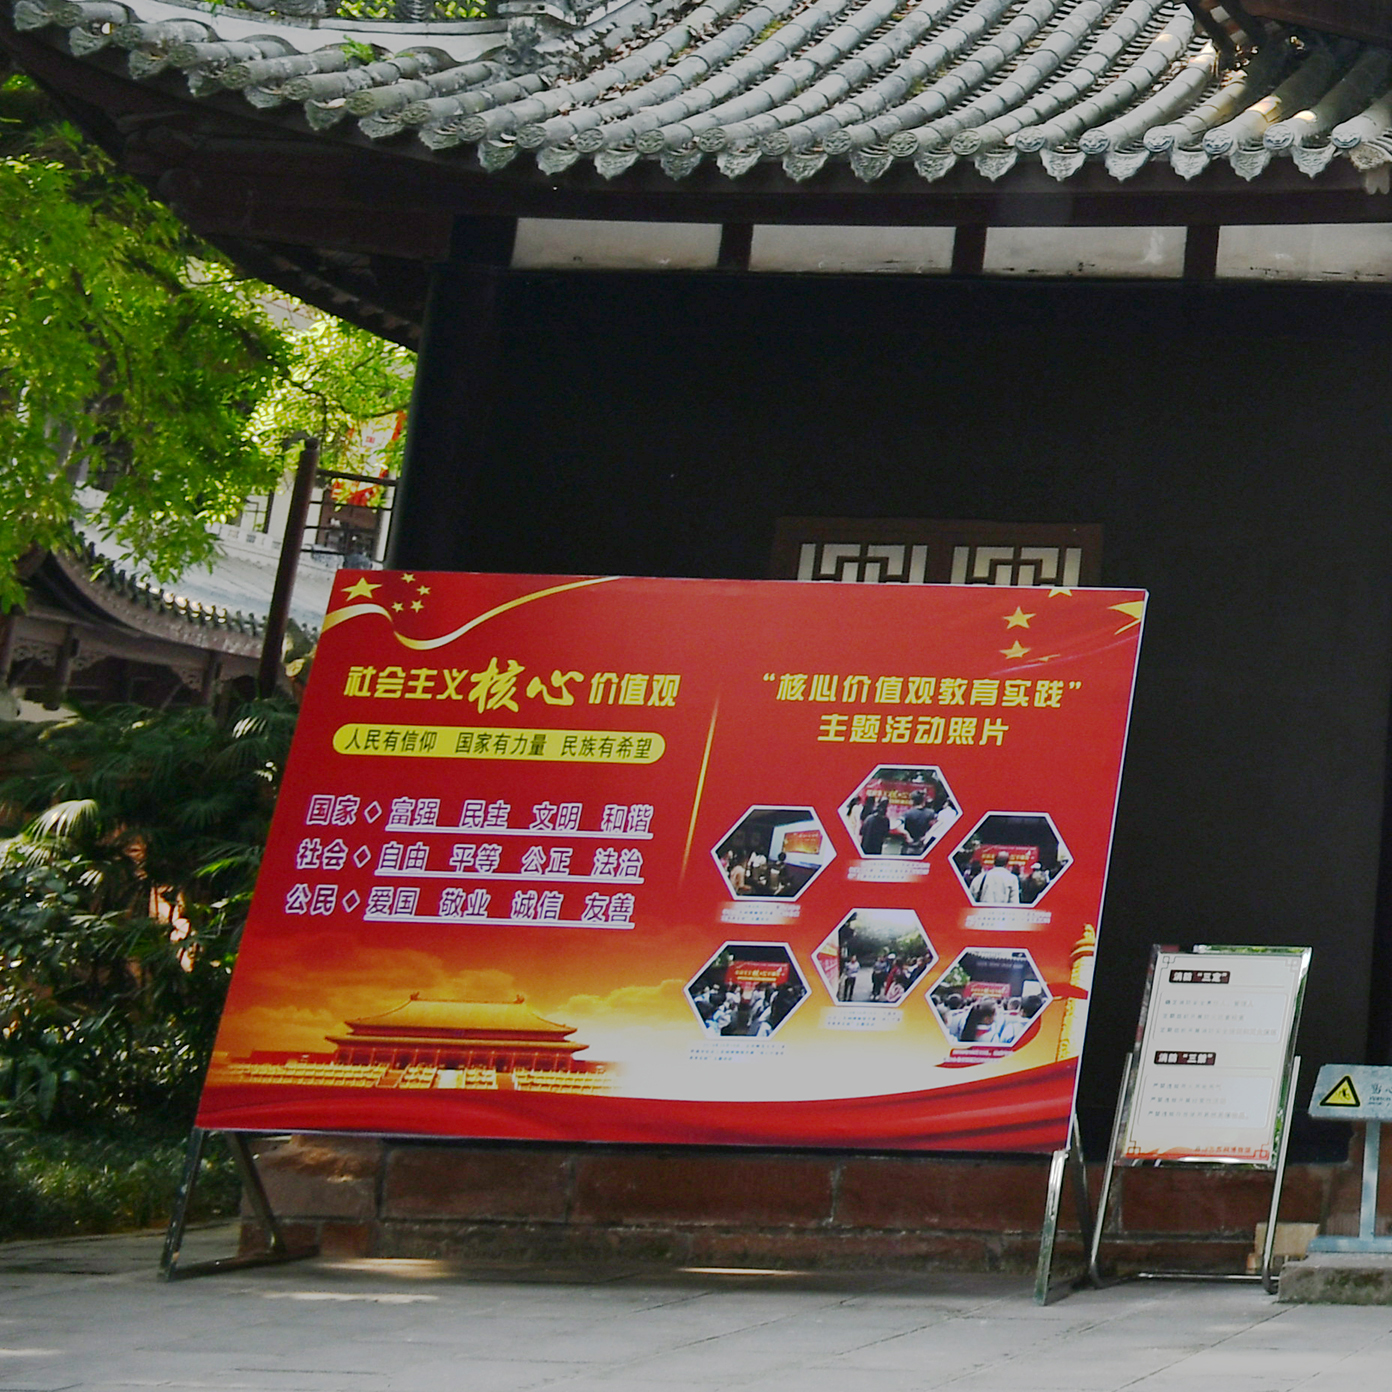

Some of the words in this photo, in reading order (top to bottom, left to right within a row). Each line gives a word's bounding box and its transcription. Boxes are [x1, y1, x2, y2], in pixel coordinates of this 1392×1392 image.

[344, 657, 681, 714] 社会主义核心价值观
[762, 672, 1082, 708] “核心价值观教育实践”
[344, 729, 438, 754] 人民有信仰
[455, 732, 547, 757] 国家有力量
[560, 736, 653, 760] 民族有希望
[817, 714, 1009, 746] 主题活动照片
[306, 795, 359, 825] 国家
[388, 798, 440, 828] 富强
[459, 800, 510, 830] 民主
[529, 802, 582, 832] 文明
[600, 805, 653, 835] 和谐
[296, 839, 348, 870] 社会
[378, 842, 429, 872] 自由
[449, 844, 501, 874] 平等
[520, 846, 573, 876] 公正
[592, 848, 644, 878] 法治
[285, 884, 338, 915] 公民
[366, 887, 420, 917] 爱国
[439, 888, 491, 919] 敬业
[511, 890, 563, 921] 诚信
[581, 893, 635, 923] 友善
